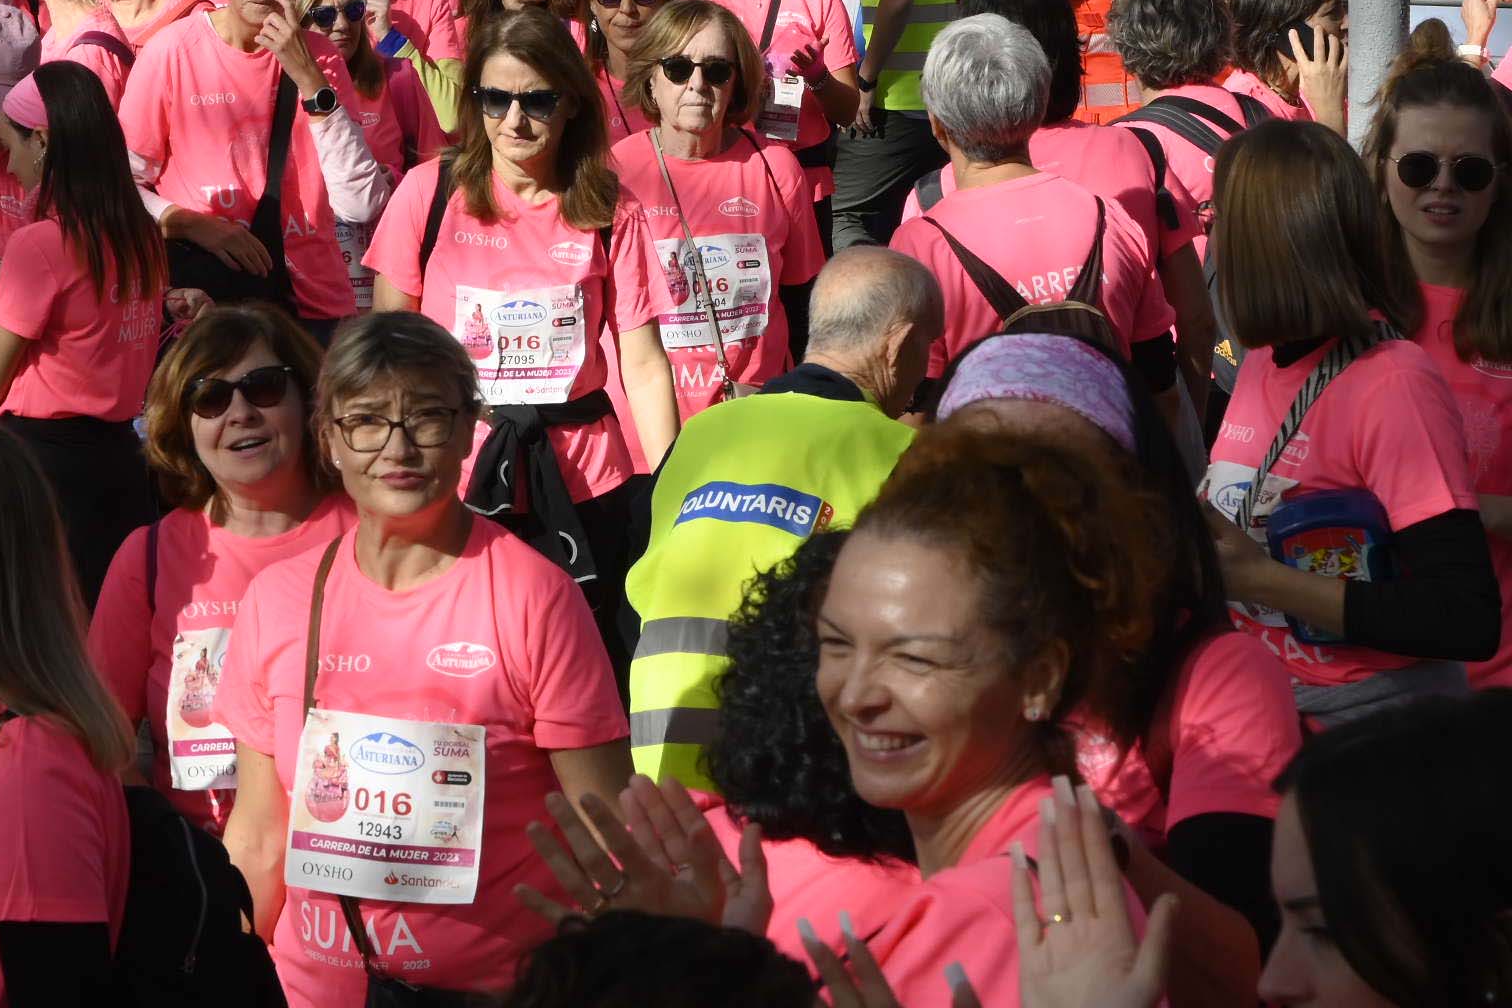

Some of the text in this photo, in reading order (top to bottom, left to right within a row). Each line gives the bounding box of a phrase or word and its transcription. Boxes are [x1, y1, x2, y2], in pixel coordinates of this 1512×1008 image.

[190, 92, 236, 106] OYSHO
[199, 183, 237, 209] TU
[643, 205, 679, 218] YSHO
[454, 231, 508, 250] OYSHO
[668, 314, 700, 323] CARRERA
[118, 318, 157, 343] MUJER
[666, 329, 702, 339] OYSHO
[499, 335, 541, 351] 016
[499, 354, 536, 365] 27095
[1214, 345, 1238, 367] adidas
[526, 369, 554, 377] MUJER
[182, 600, 239, 618] OYSH
[431, 654, 490, 670] ASTURIANA
[190, 742, 235, 752] CARRERA
[432, 747, 471, 759] SUMA
[356, 745, 418, 767] ASTURIANA
[187, 764, 236, 778] OYSHO
[354, 787, 412, 816] 016
[357, 820, 403, 840] 12943
[310, 838, 356, 854] CARRERA
[357, 845, 373, 856] DE
[373, 847, 387, 858] LA
[389, 850, 429, 861] MUJER
[302, 861, 461, 890] OYSHO Santander
[300, 900, 424, 956] SUMA
[402, 959, 432, 970] 2023
